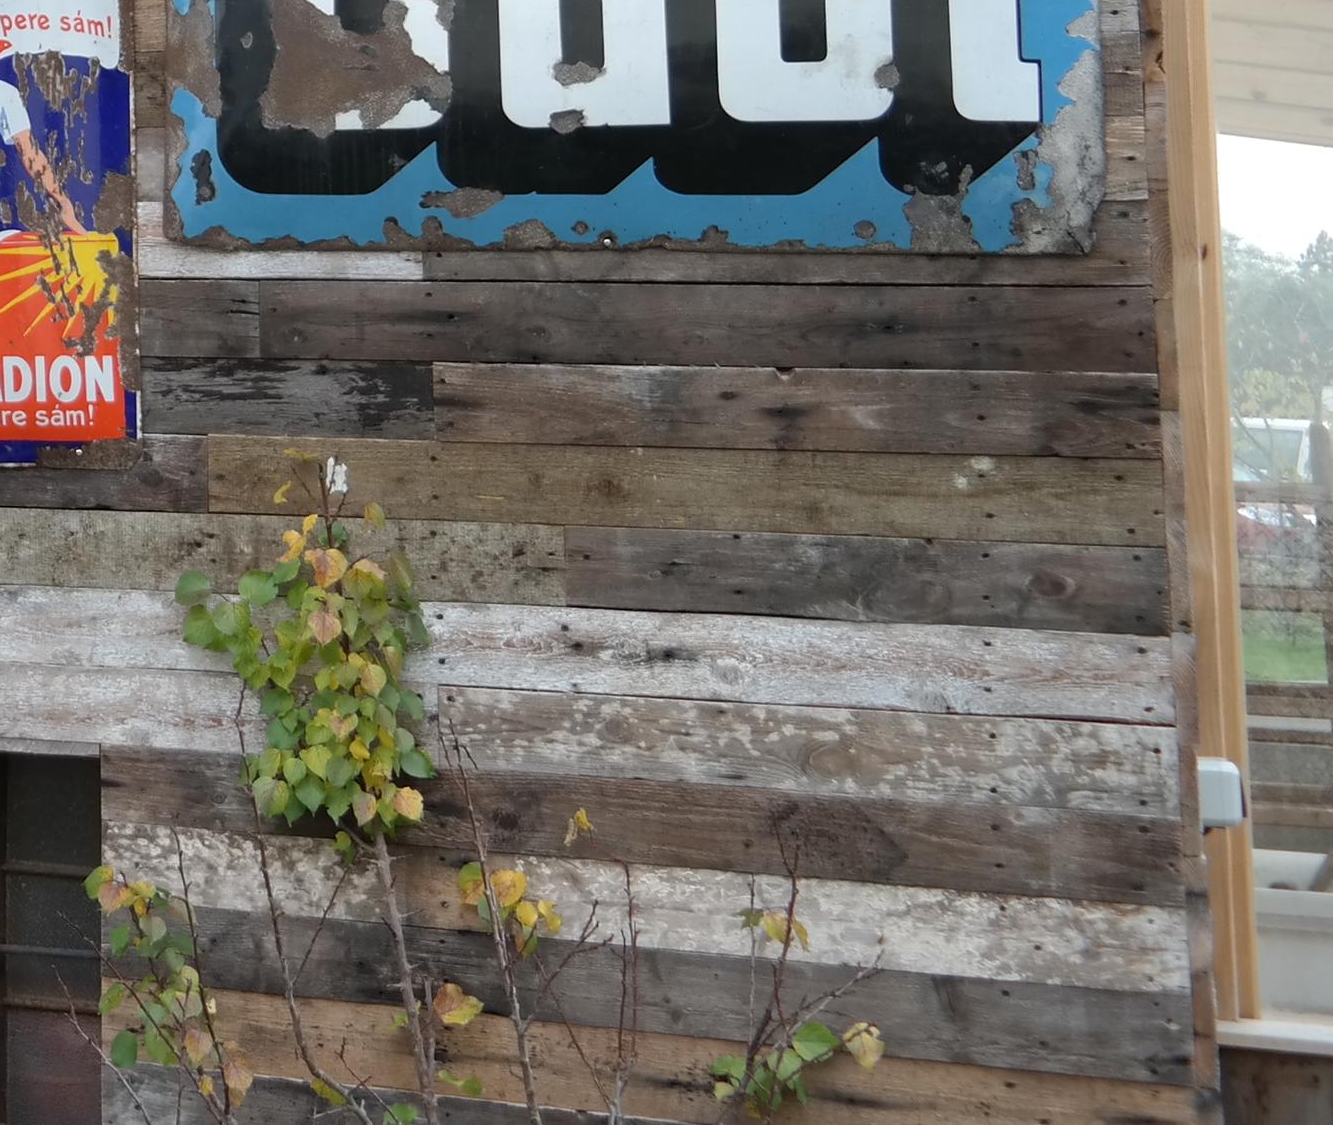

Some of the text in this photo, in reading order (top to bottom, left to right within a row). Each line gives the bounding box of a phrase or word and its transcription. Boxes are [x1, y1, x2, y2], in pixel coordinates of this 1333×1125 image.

[0, 11, 112, 38] pere sám!
[35, 404, 94, 426] sám!
